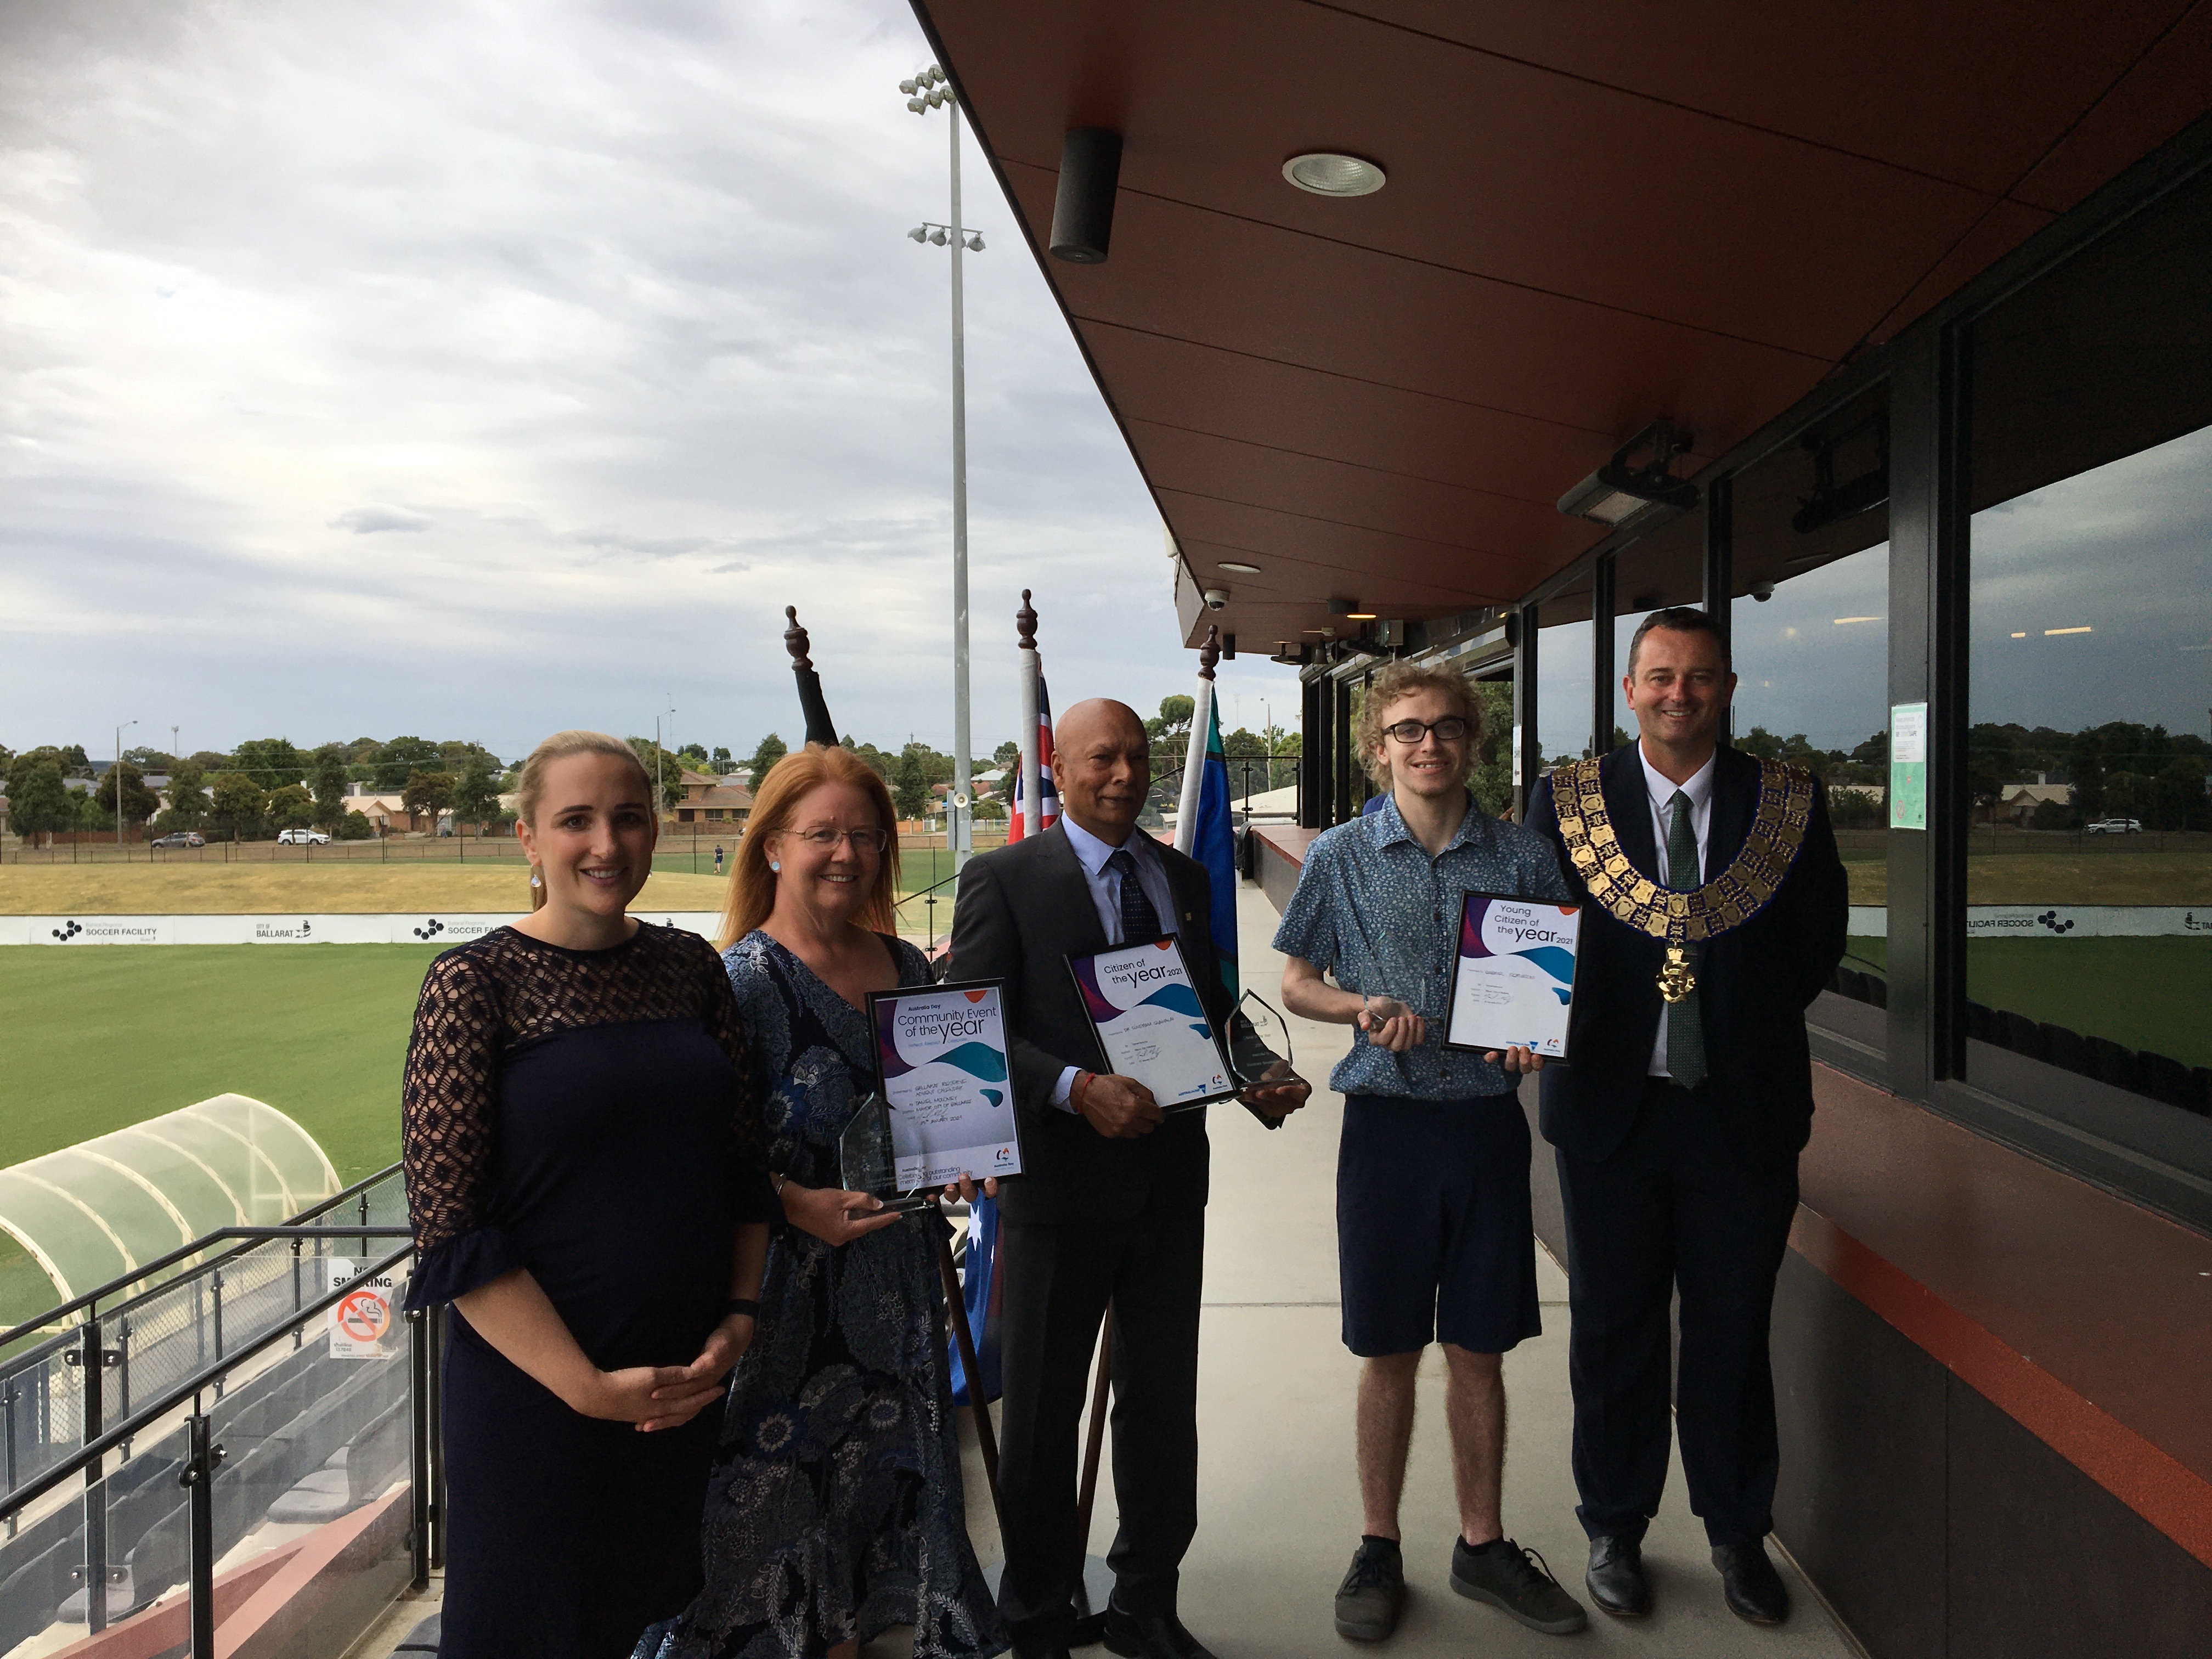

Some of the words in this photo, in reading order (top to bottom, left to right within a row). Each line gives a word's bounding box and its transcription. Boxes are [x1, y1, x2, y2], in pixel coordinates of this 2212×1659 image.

[1500, 905, 1531, 917] Young
[1494, 915, 1527, 925] Citizen
[1498, 926, 1513, 934] the
[1515, 927, 1558, 943] year
[1104, 962, 1135, 974] Citizen
[1136, 958, 1146, 968] of
[1112, 975, 1128, 984] the
[1127, 966, 1166, 989] year
[1167, 968, 1183, 977] 2021
[898, 1010, 964, 1026] Community
[967, 1007, 997, 1019] Event
[905, 1028, 917, 1037] of
[919, 1025, 938, 1036] the
[938, 1019, 984, 1044] year
[928, 1166, 961, 1176] outstanding
[333, 1277, 392, 1288] SMING
